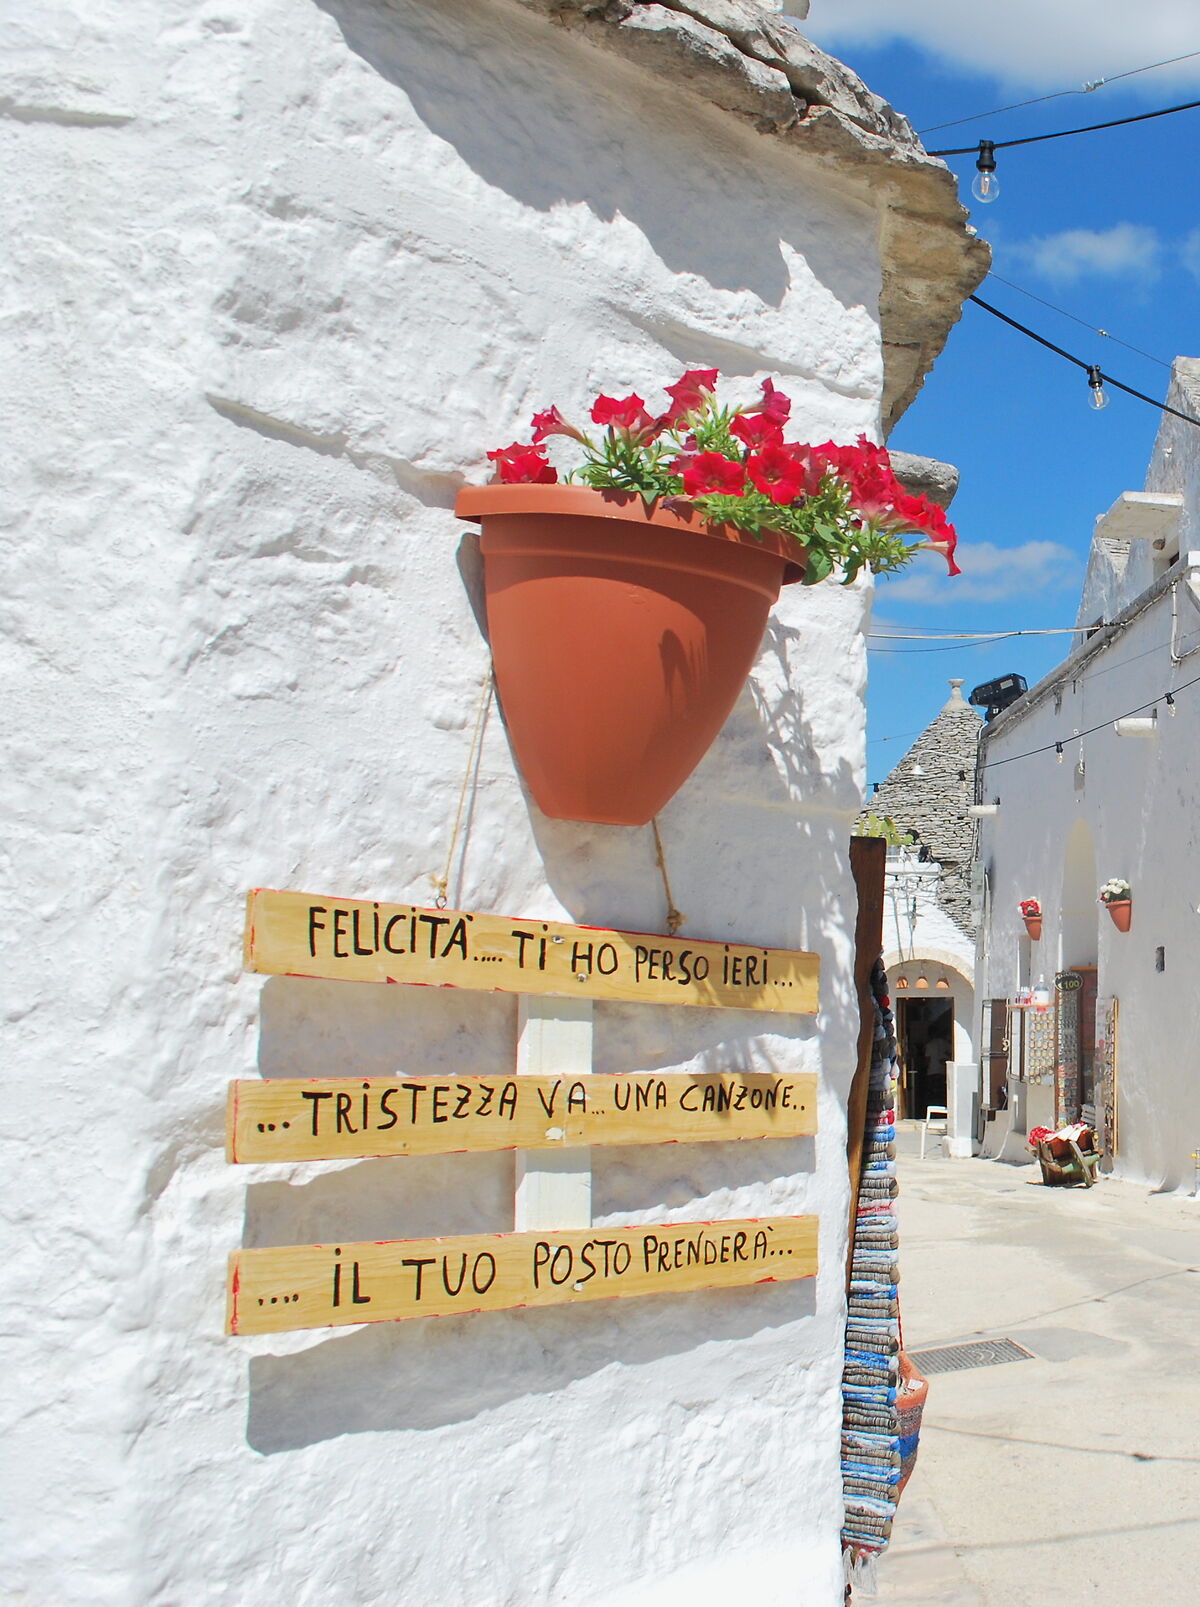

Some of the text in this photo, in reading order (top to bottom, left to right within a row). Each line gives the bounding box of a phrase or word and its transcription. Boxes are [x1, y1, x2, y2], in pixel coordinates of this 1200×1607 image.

[511, 923, 550, 970] TI
[571, 942, 618, 974] HO
[635, 944, 709, 985] PERSO
[614, 1078, 667, 1111] UNA
[333, 1247, 371, 1307] IL
[402, 1252, 496, 1301] TUO
[534, 1239, 631, 1289] POSTO
